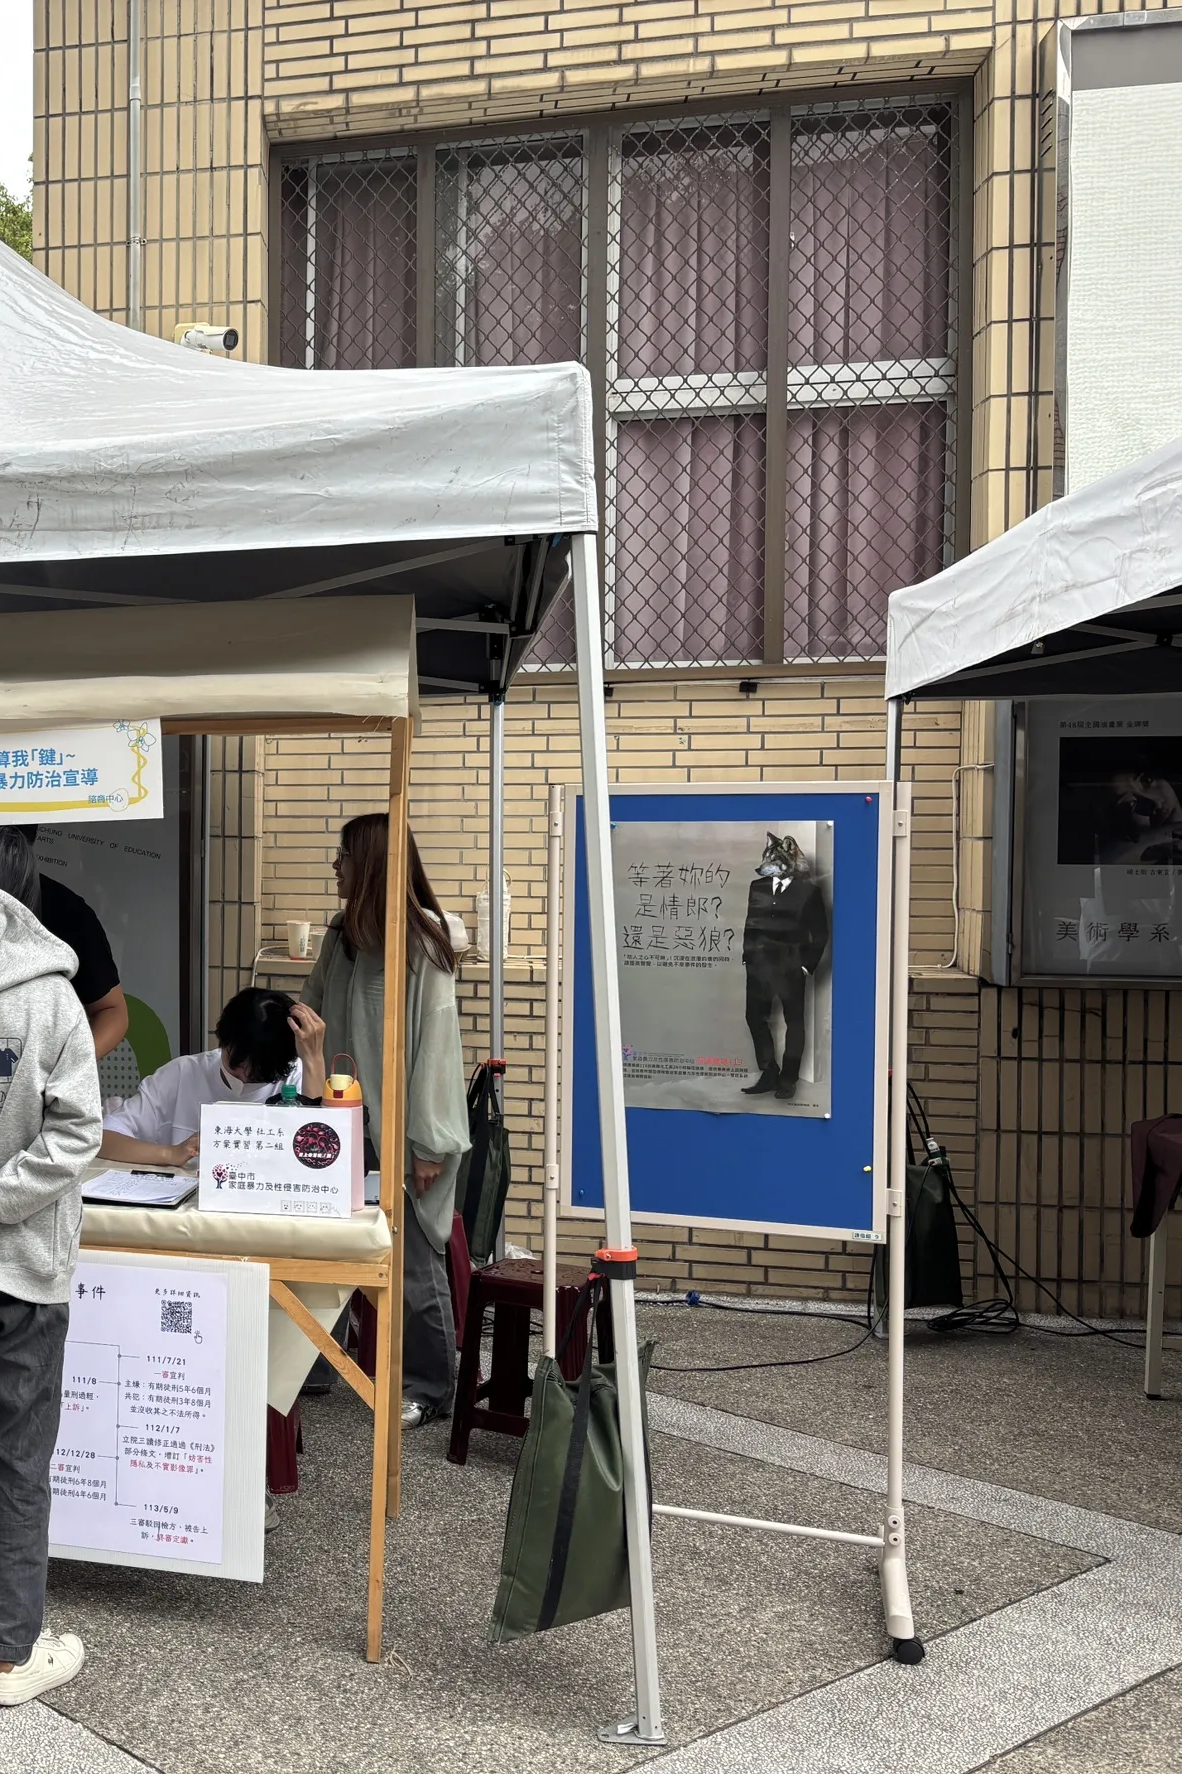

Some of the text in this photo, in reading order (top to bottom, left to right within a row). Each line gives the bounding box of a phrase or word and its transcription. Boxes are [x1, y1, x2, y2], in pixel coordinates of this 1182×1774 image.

[36, 836, 54, 845] ARTS
[68, 833, 105, 846] UNIVERSITY
[123, 846, 162, 860] EDUCATION
[37, 855, 68, 867] XHIBITION
[627, 861, 730, 890] 等著妳的
[635, 893, 722, 920] 是情郎?
[1056, 921, 1171, 942] 美術學系
[622, 925, 735, 952] 還是惡狼?
[214, 1125, 285, 1137] 東海大學 社工系
[213, 1139, 284, 1151] 方案實習 第二組
[228, 1171, 255, 1181] 臺中市
[228, 1181, 339, 1194] 家庭暴力及性侵害防治中心
[75, 1282, 106, 1300] 事件
[154, 1288, 200, 1298] 更多詳細資訊
[147, 1355, 186, 1366] 111/7/21
[72, 1376, 97, 1385] 111/8
[154, 1371, 185, 1380] 一審宣判
[124, 1379, 211, 1396] 主嫌：有期徒刑5年6個月
[62, 1390, 98, 1400] 量刑過輕，
[124, 1392, 211, 1408] 共犯：有期徒刑3年8個月
[130, 1405, 206, 1419] 並沒收其之不法所得。
[146, 1423, 180, 1434] 112/1/7
[122, 1435, 215, 1452] 立院三讀修正通過《刑法》
[144, 1503, 179, 1514] 113/5/9
